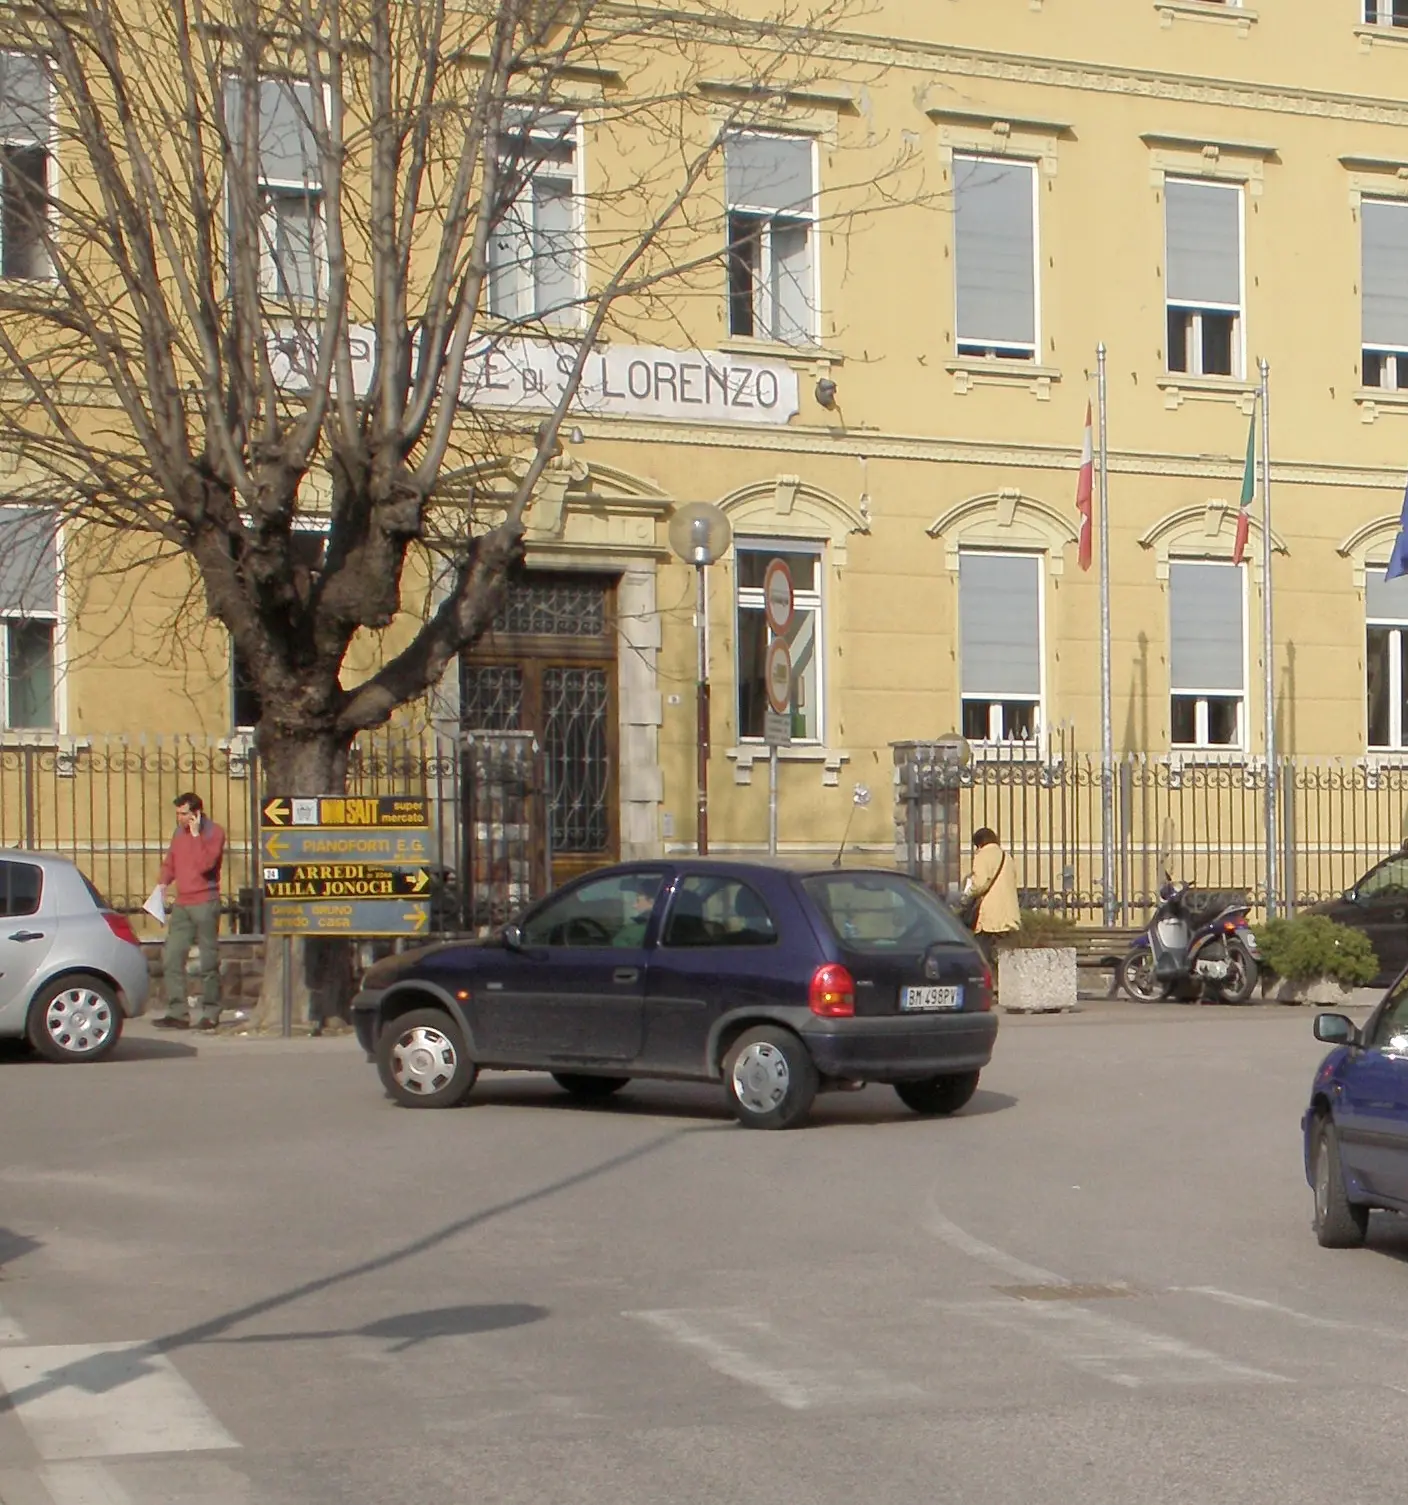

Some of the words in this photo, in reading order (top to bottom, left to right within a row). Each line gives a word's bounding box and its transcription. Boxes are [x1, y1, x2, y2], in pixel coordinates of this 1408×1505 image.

[602, 357, 778, 408] LORENZO
[394, 802, 423, 811] super
[381, 813, 424, 823] mercato
[303, 839, 390, 852] PIANOFORTI
[294, 865, 364, 880] ARREDI
[266, 882, 316, 896] VILLA
[322, 880, 393, 896] JONOCH
